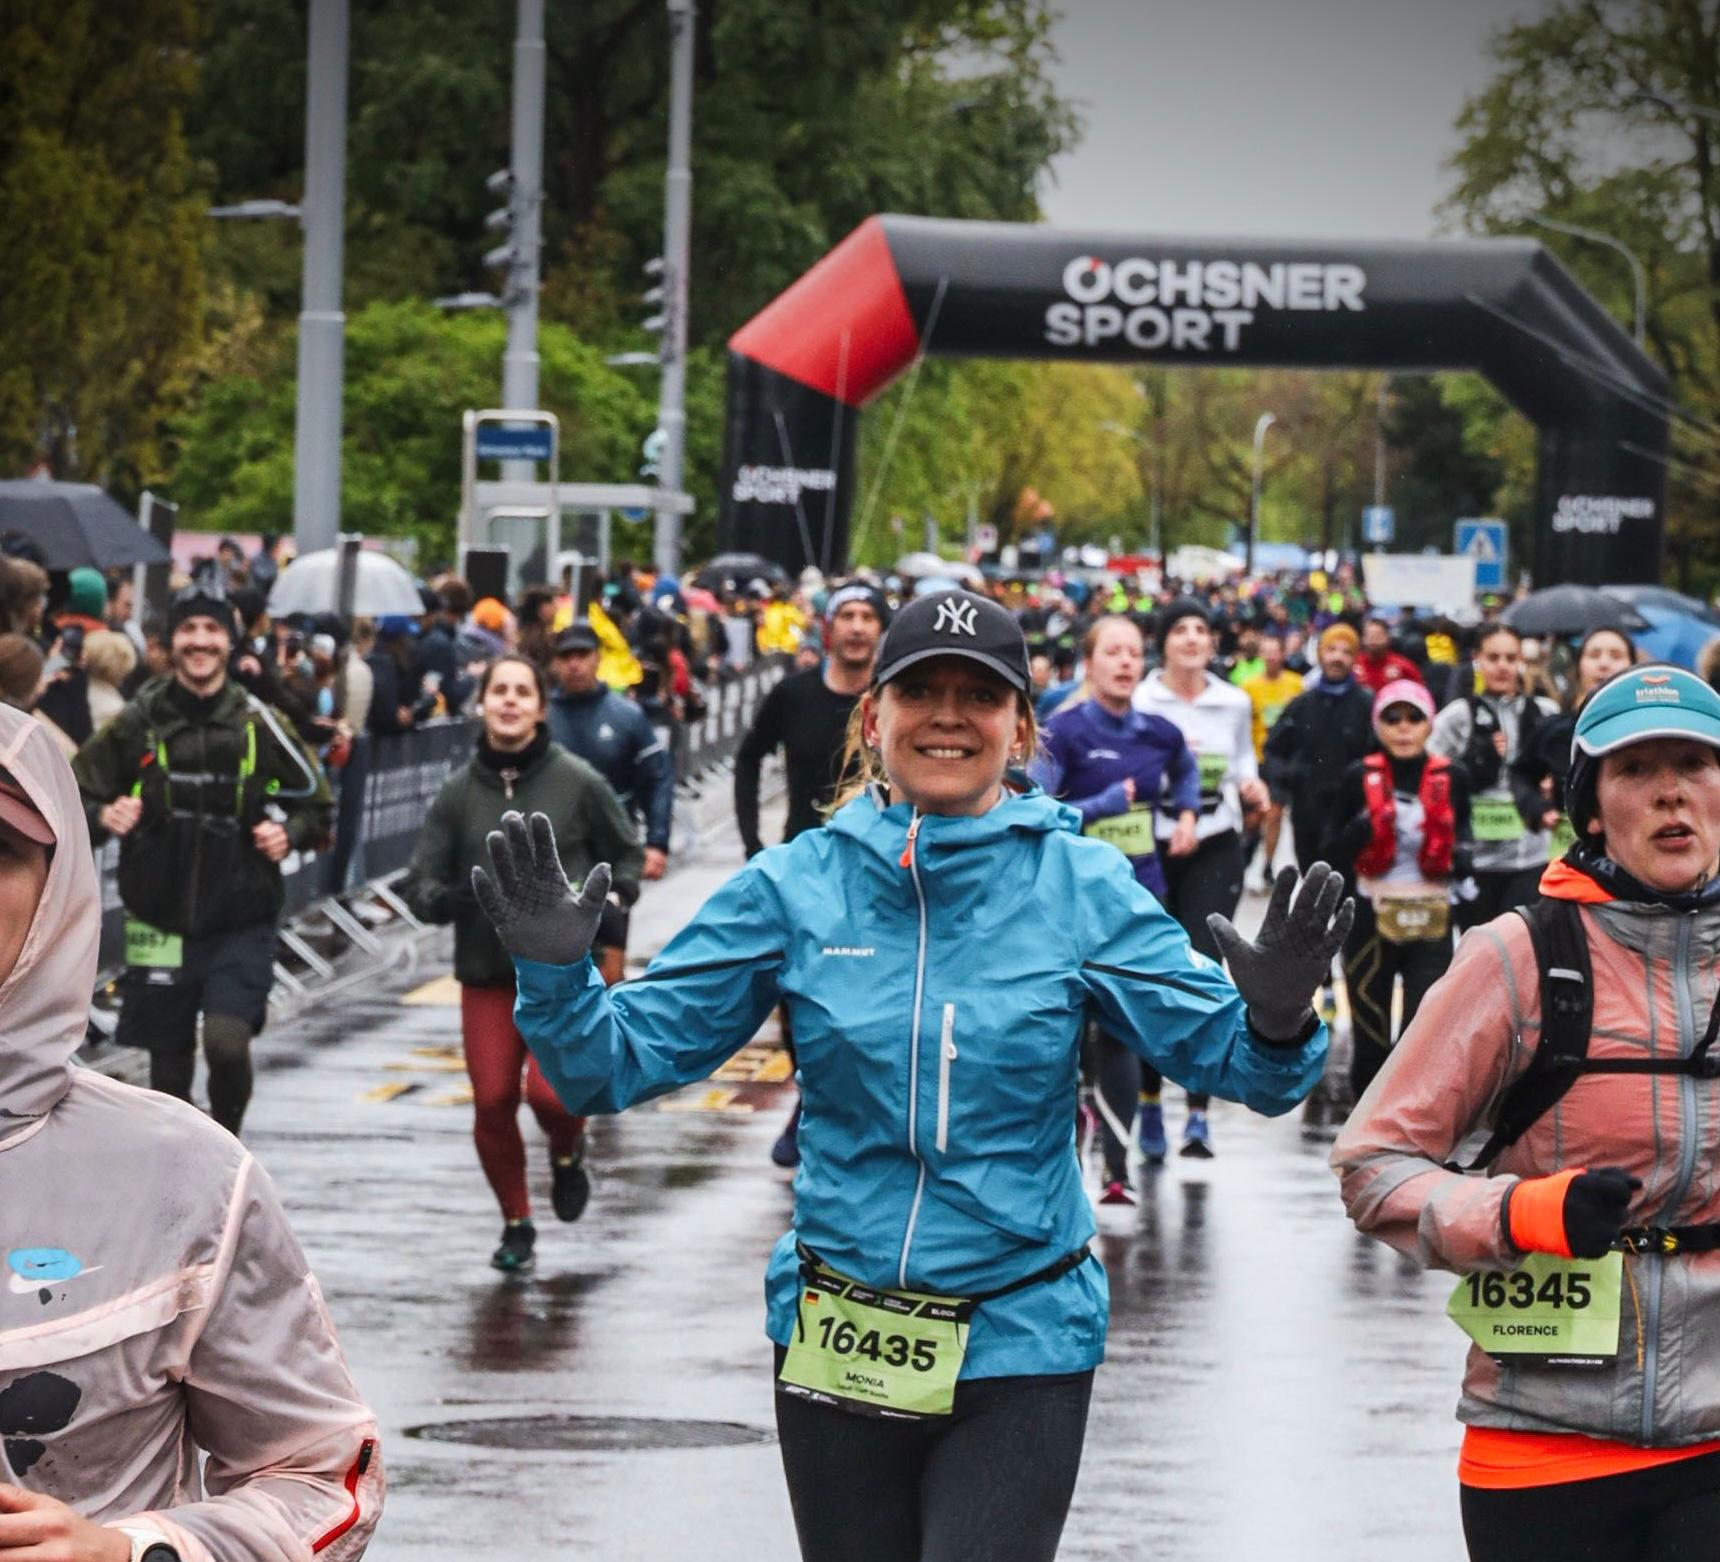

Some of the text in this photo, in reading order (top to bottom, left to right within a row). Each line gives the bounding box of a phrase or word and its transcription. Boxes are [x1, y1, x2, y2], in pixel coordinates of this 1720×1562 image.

[1044, 302, 1254, 350] SPORT
[822, 947, 876, 957] MAMMUT
[1466, 1271, 1592, 1310] 16345
[930, 1308, 957, 1318] BLOCK
[1493, 1324, 1559, 1337] FLORENCE
[818, 1316, 938, 1373] 16435
[845, 1371, 885, 1389] MONIA
